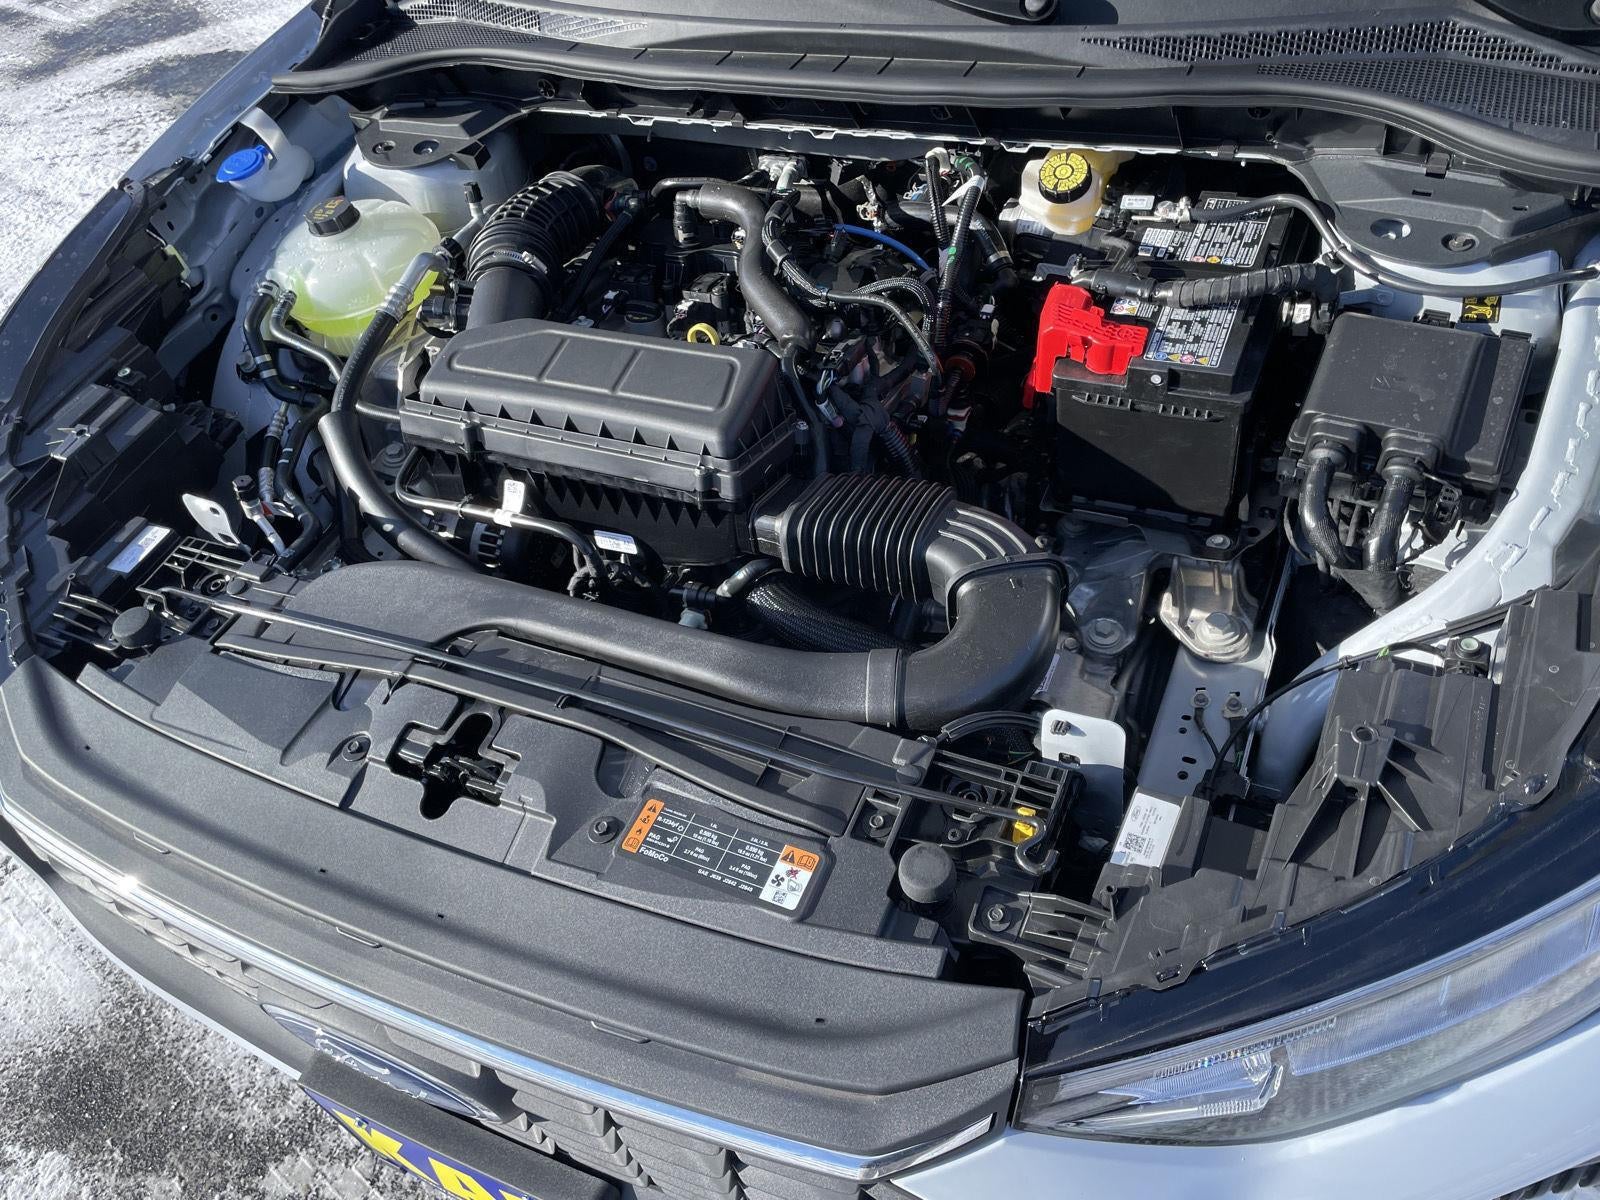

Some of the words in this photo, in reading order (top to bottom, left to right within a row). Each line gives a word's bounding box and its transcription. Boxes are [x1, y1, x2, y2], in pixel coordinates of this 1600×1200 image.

[657, 816, 679, 828] R-1234yf
[648, 832, 660, 840] PAG
[639, 847, 669, 862] FoMoCo
[331, 1108, 524, 1200] KA
